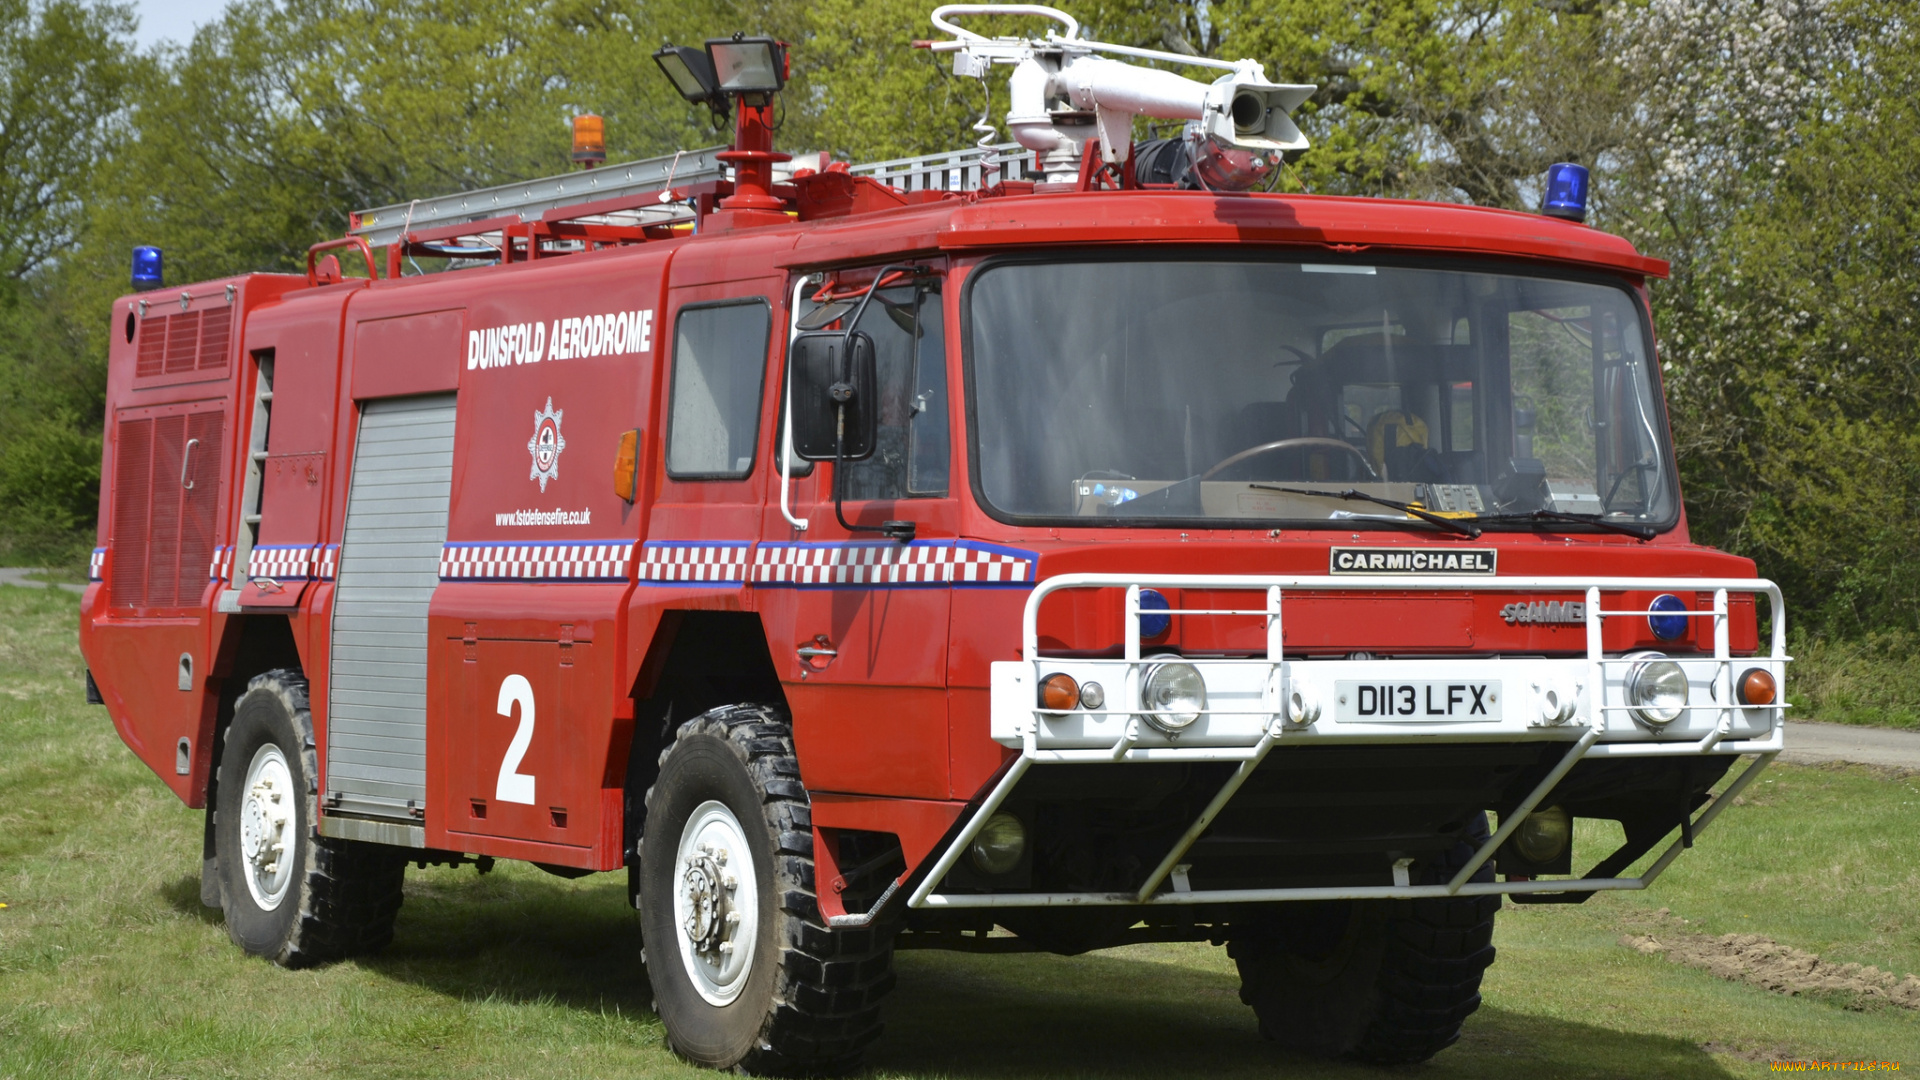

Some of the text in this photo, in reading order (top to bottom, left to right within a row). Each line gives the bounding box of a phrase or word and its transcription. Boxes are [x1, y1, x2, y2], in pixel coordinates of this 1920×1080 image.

[467, 309, 653, 370] DUNSFOLD AERODROME
[495, 506, 591, 526] www.1stdefensefire.co.uk
[1338, 552, 1489, 571] CARMICHAEL
[1358, 685, 1487, 715] D113 LFX
[495, 673, 536, 806] 2
